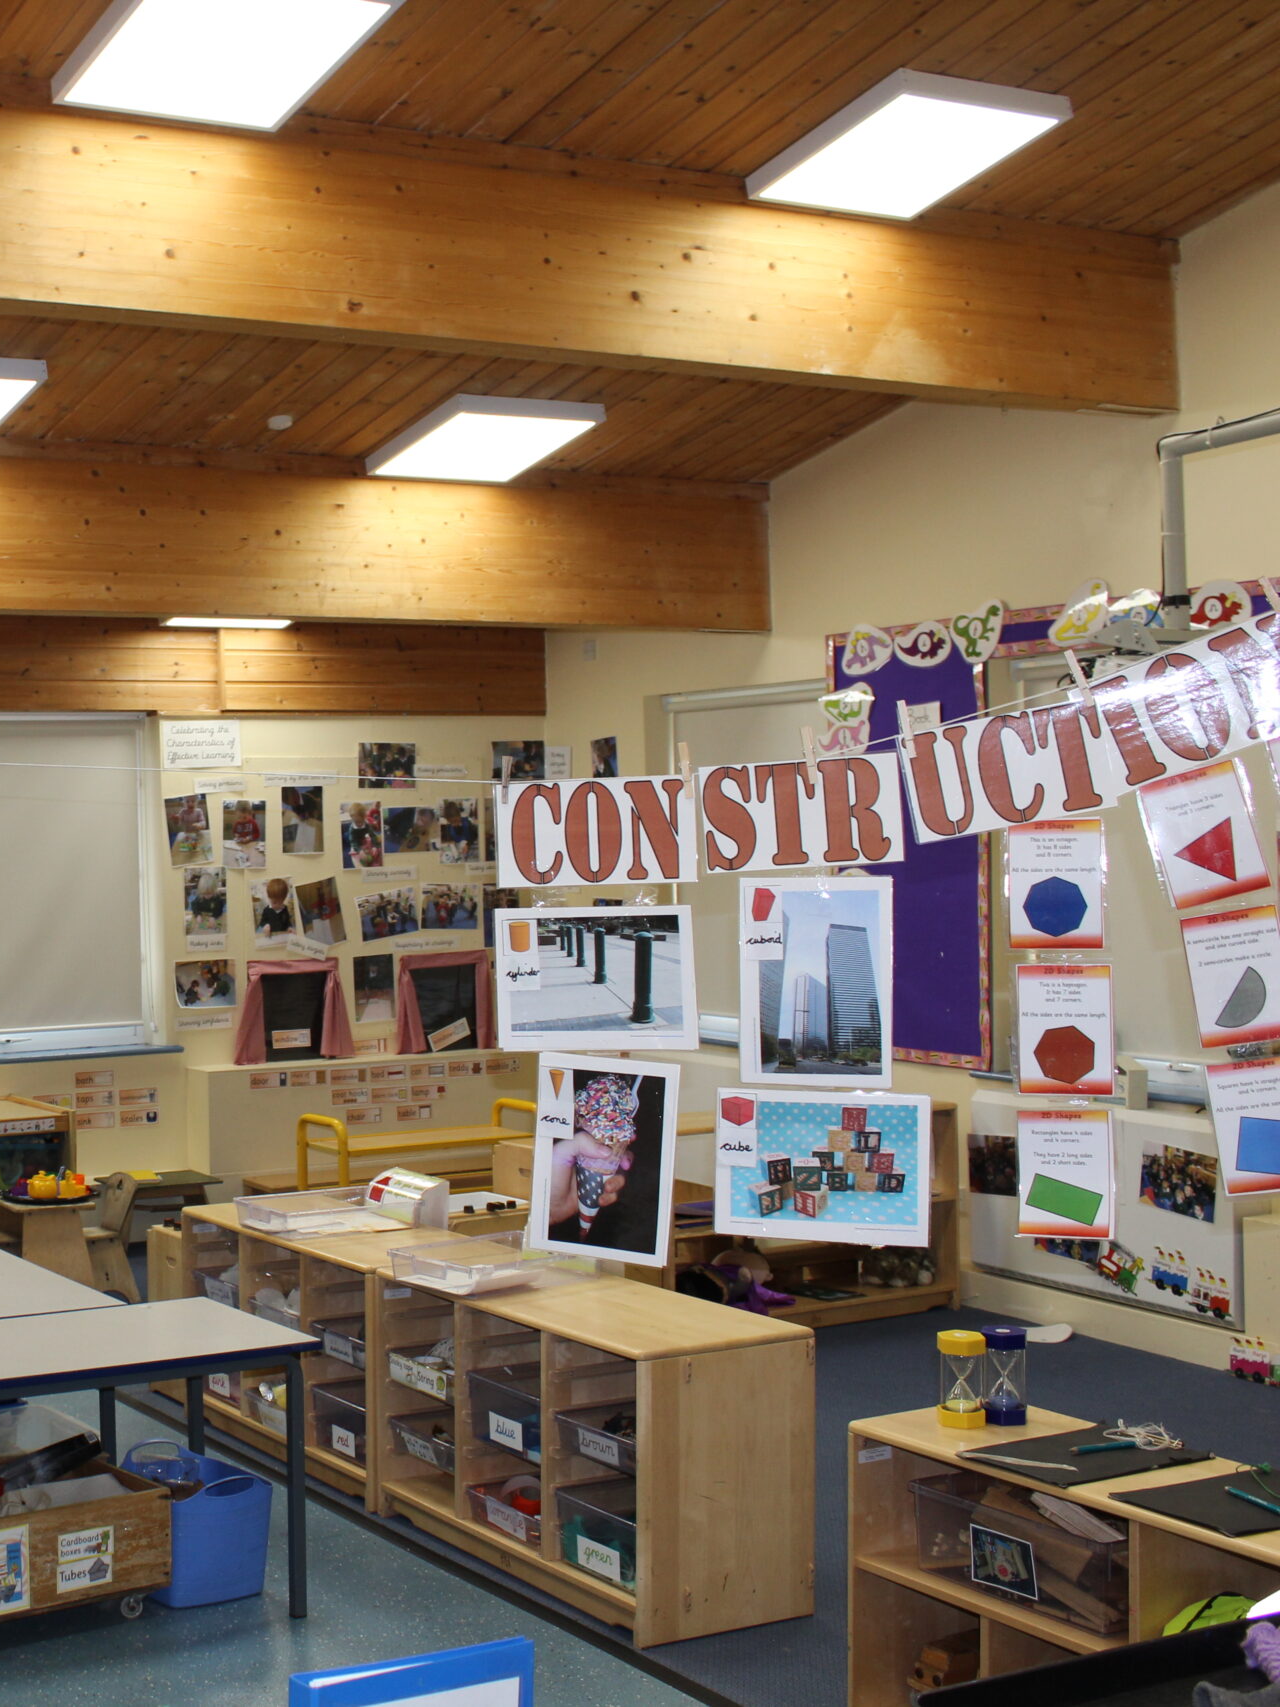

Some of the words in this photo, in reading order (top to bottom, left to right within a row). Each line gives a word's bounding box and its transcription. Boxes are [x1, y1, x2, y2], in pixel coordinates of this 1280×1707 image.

[170, 725, 215, 736] Celebrating
[217, 725, 229, 734] the
[166, 738, 225, 749] Characteristics
[227, 737, 236, 750] of
[167, 751, 199, 764] Effective
[201, 751, 236, 762] Learning
[1048, 822, 1074, 832] Shapes
[1222, 913, 1249, 923] Shapes
[746, 930, 782, 945] cuboid
[506, 963, 540, 982] cylinder
[1057, 967, 1083, 976] Shapes
[449, 1063, 469, 1075] teddy
[1233, 1061, 1244, 1070] 2D
[1247, 1059, 1275, 1069] Shapes
[251, 1075, 268, 1086] door
[371, 1069, 385, 1079] bed
[1261, 1076, 1280, 1086] straigh
[540, 1114, 570, 1127] cone
[1055, 1111, 1081, 1120] Shapes
[720, 1141, 753, 1154] cube
[495, 1419, 516, 1440] blue
[336, 1435, 350, 1448] red
[580, 1430, 616, 1457] brown
[61, 1534, 100, 1549] Cardboard
[61, 1548, 81, 1559] boxes
[584, 1545, 613, 1566] green
[60, 1569, 87, 1583] Tubes
